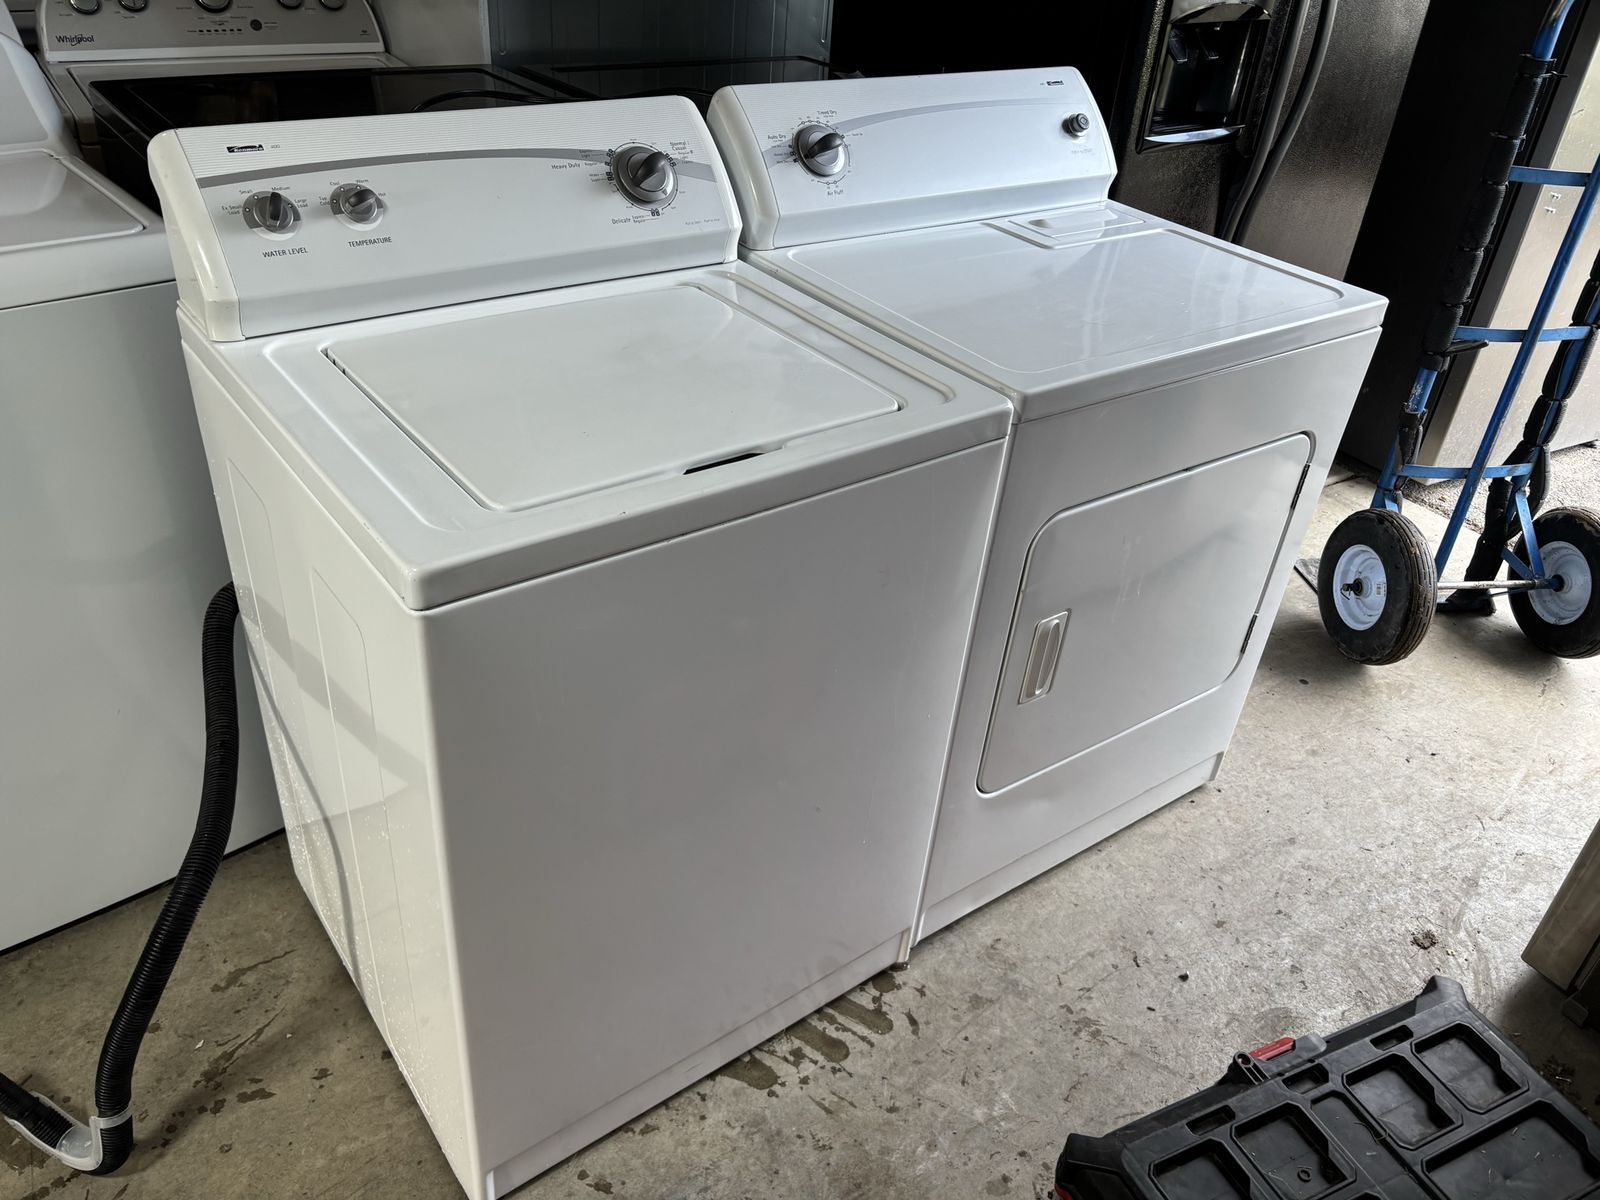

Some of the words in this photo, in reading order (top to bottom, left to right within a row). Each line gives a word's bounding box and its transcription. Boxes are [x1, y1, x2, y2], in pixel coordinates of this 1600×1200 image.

[56, 34, 94, 46] Whirlpool
[348, 236, 392, 248] TEMPERATURE
[262, 249, 287, 258] WATER
[288, 247, 308, 256] LEVEL
